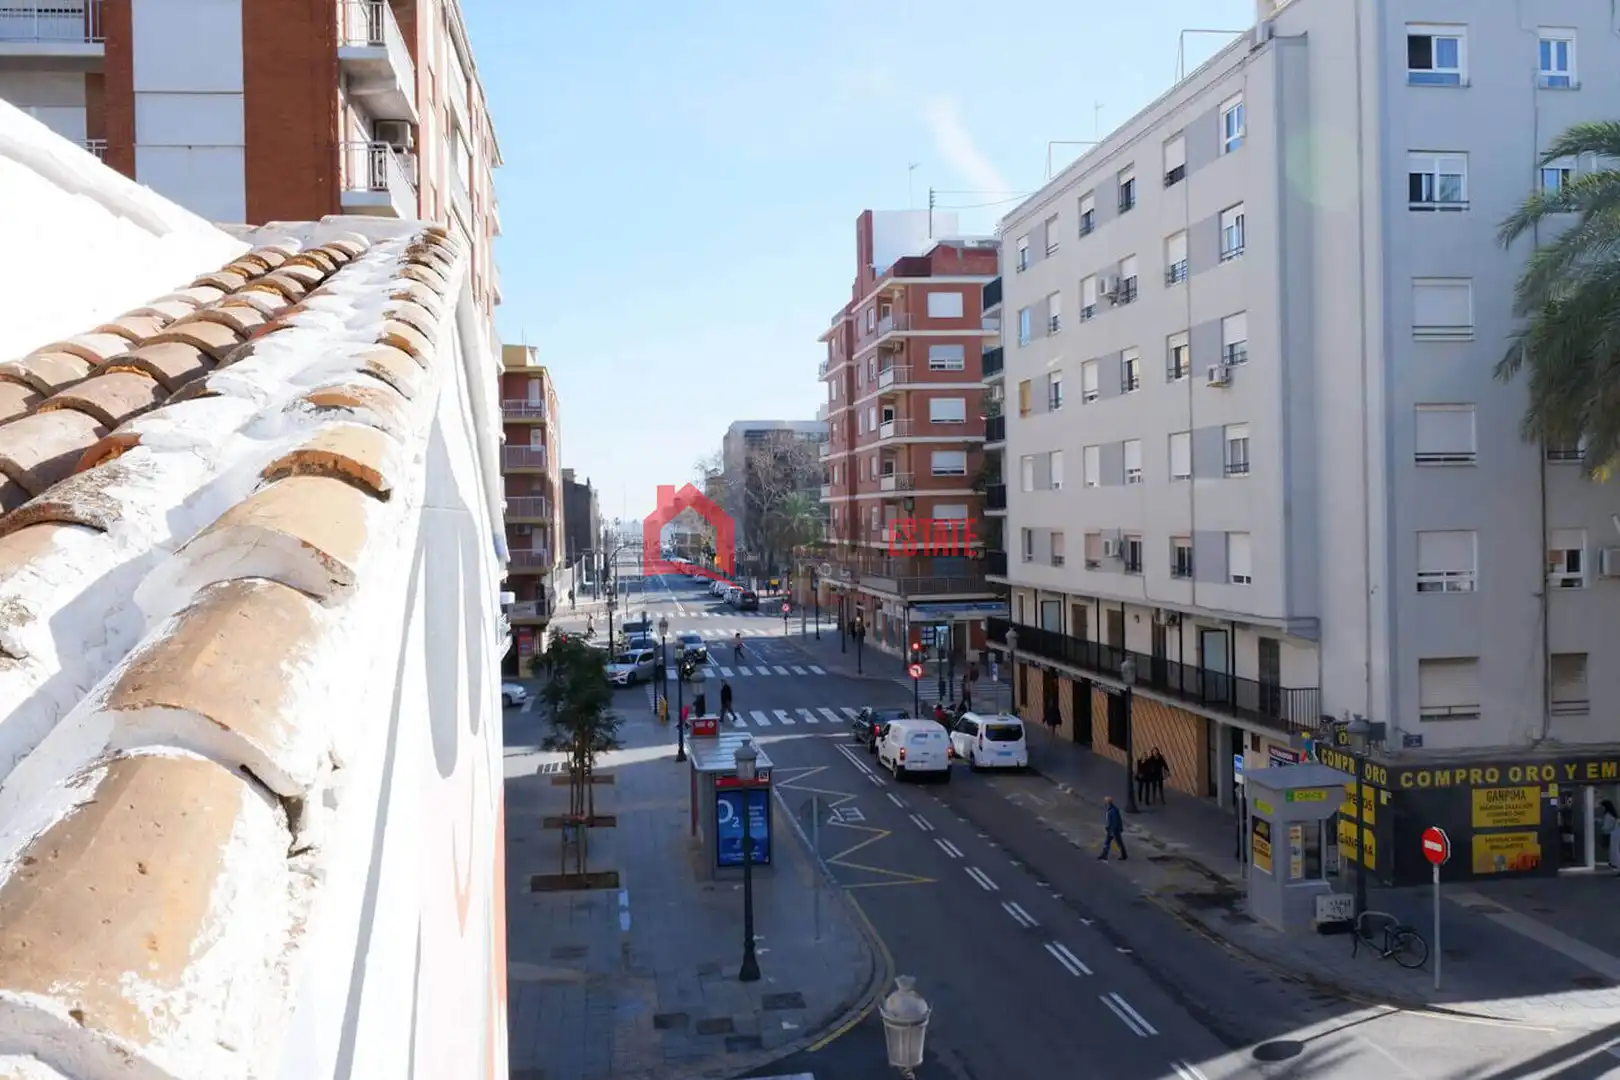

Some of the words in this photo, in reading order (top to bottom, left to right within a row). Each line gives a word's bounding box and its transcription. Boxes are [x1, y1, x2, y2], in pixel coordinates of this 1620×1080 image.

[1320, 747, 1357, 776] COMPR
[1364, 762, 1387, 786] ORO
[1400, 768, 1500, 788] COMPRO
[1508, 764, 1556, 783] ORO
[1564, 763, 1578, 780] Y
[1586, 761, 1618, 780] EM
